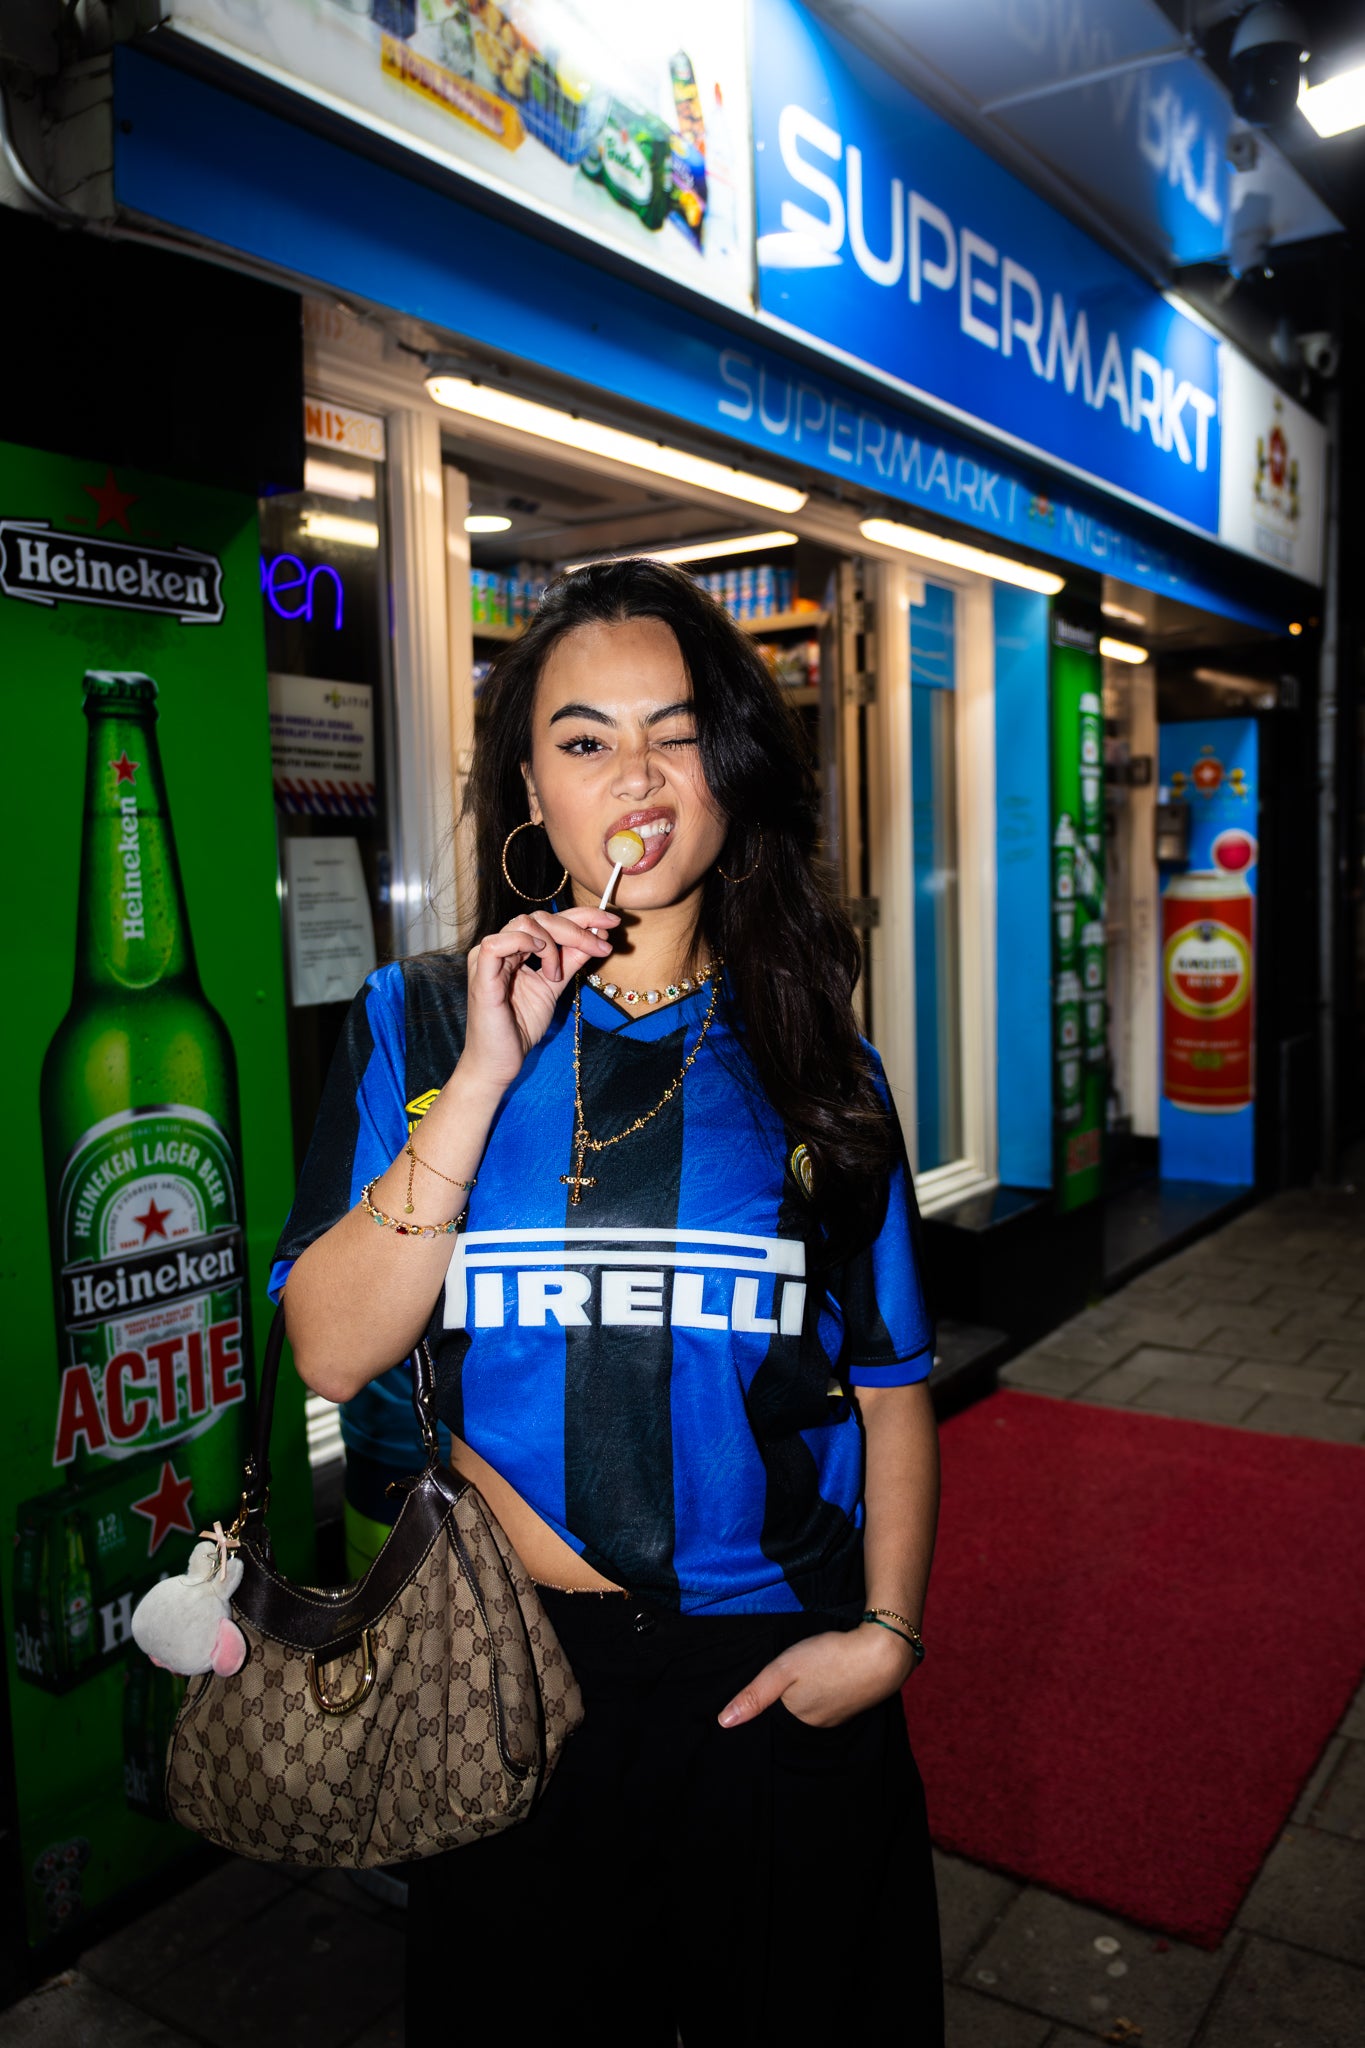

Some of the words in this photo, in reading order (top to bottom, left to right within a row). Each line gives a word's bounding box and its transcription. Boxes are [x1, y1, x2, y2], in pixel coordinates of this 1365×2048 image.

[779, 104, 1215, 472] SUPERMARKT
[16, 538, 210, 607] Heineken
[259, 553, 344, 631] en
[117, 795, 146, 942] Heineken
[73, 1146, 139, 1237] HEINEKEN
[142, 1140, 200, 1171] LAGER
[196, 1157, 227, 1209] BEER
[71, 1246, 237, 1317] Heineken
[441, 1227, 806, 1337] PIRELLI
[55, 1318, 245, 1463] ACTIE
